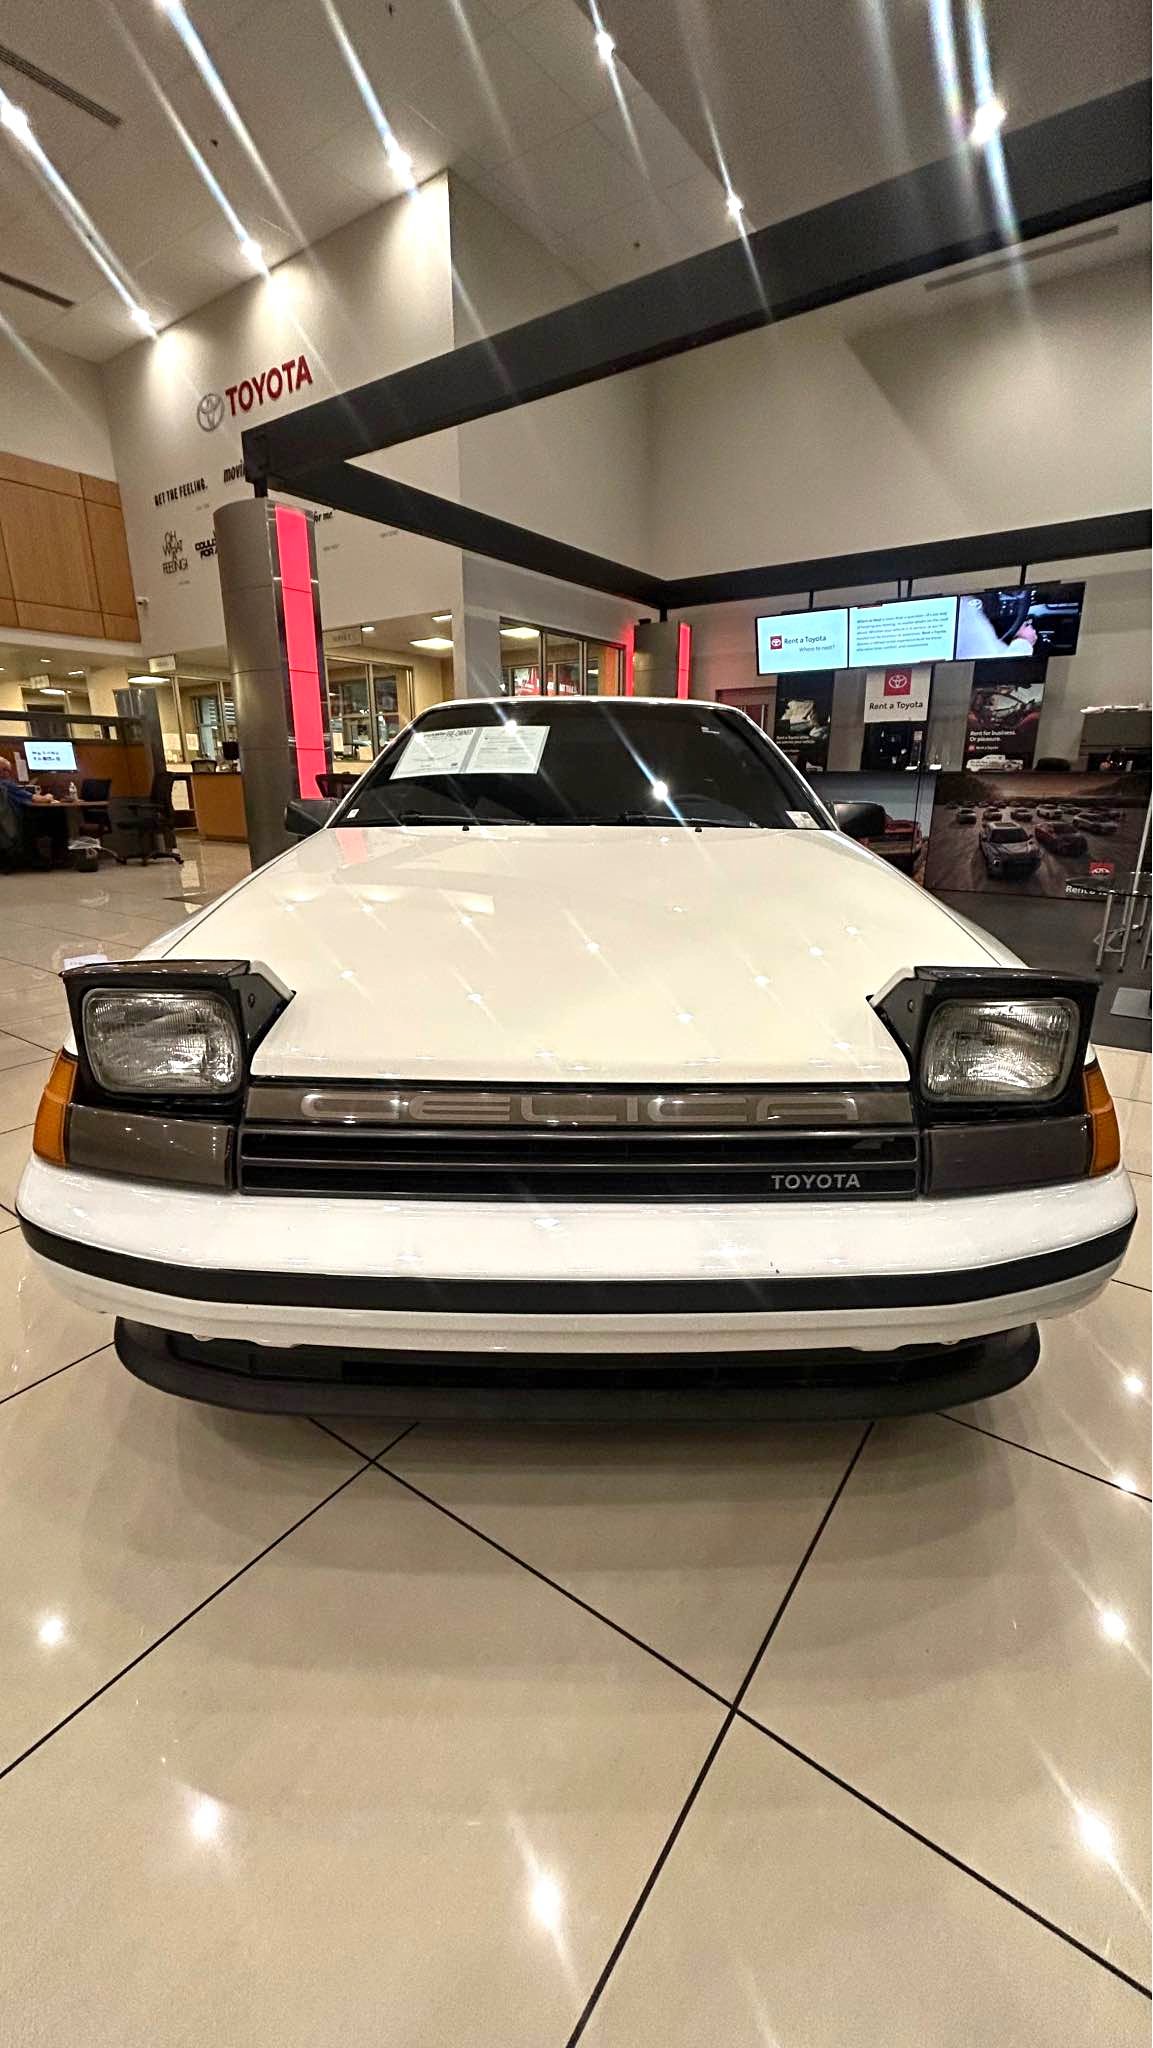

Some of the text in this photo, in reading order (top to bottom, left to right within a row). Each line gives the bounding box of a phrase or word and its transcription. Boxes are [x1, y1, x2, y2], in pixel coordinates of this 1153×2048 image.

[225, 354, 313, 417] TOYOTA
[784, 637, 799, 645] Rent
[804, 634, 827, 644] Toyota
[869, 702, 887, 710] Rent
[896, 701, 924, 711] Toyota
[300, 1093, 860, 1123] CELICA
[771, 1173, 861, 1190] TOYOTA
